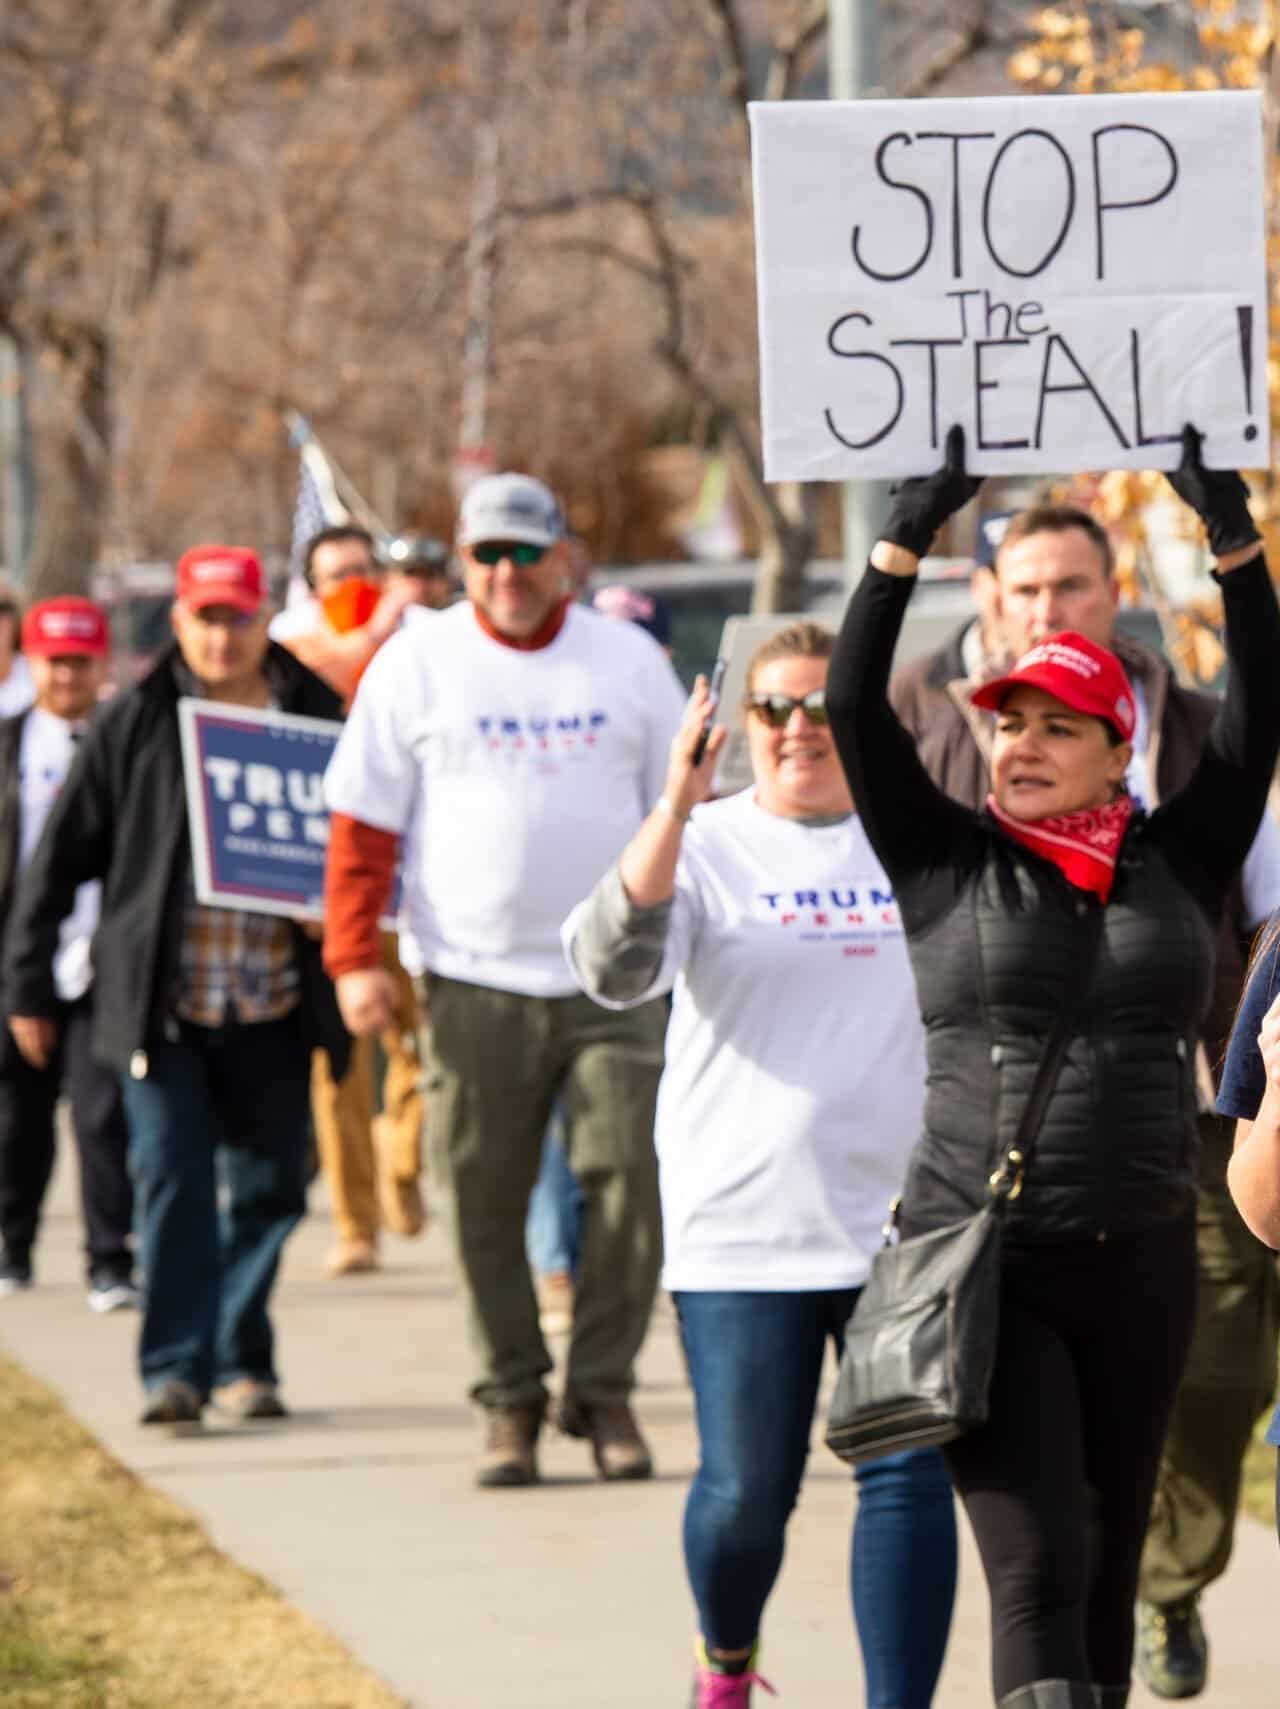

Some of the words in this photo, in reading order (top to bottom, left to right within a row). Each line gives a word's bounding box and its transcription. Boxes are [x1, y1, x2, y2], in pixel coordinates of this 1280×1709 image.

[852, 123, 1179, 282] STOP
[824, 305, 1258, 451] STEAL!
[946, 289, 1050, 340] The
